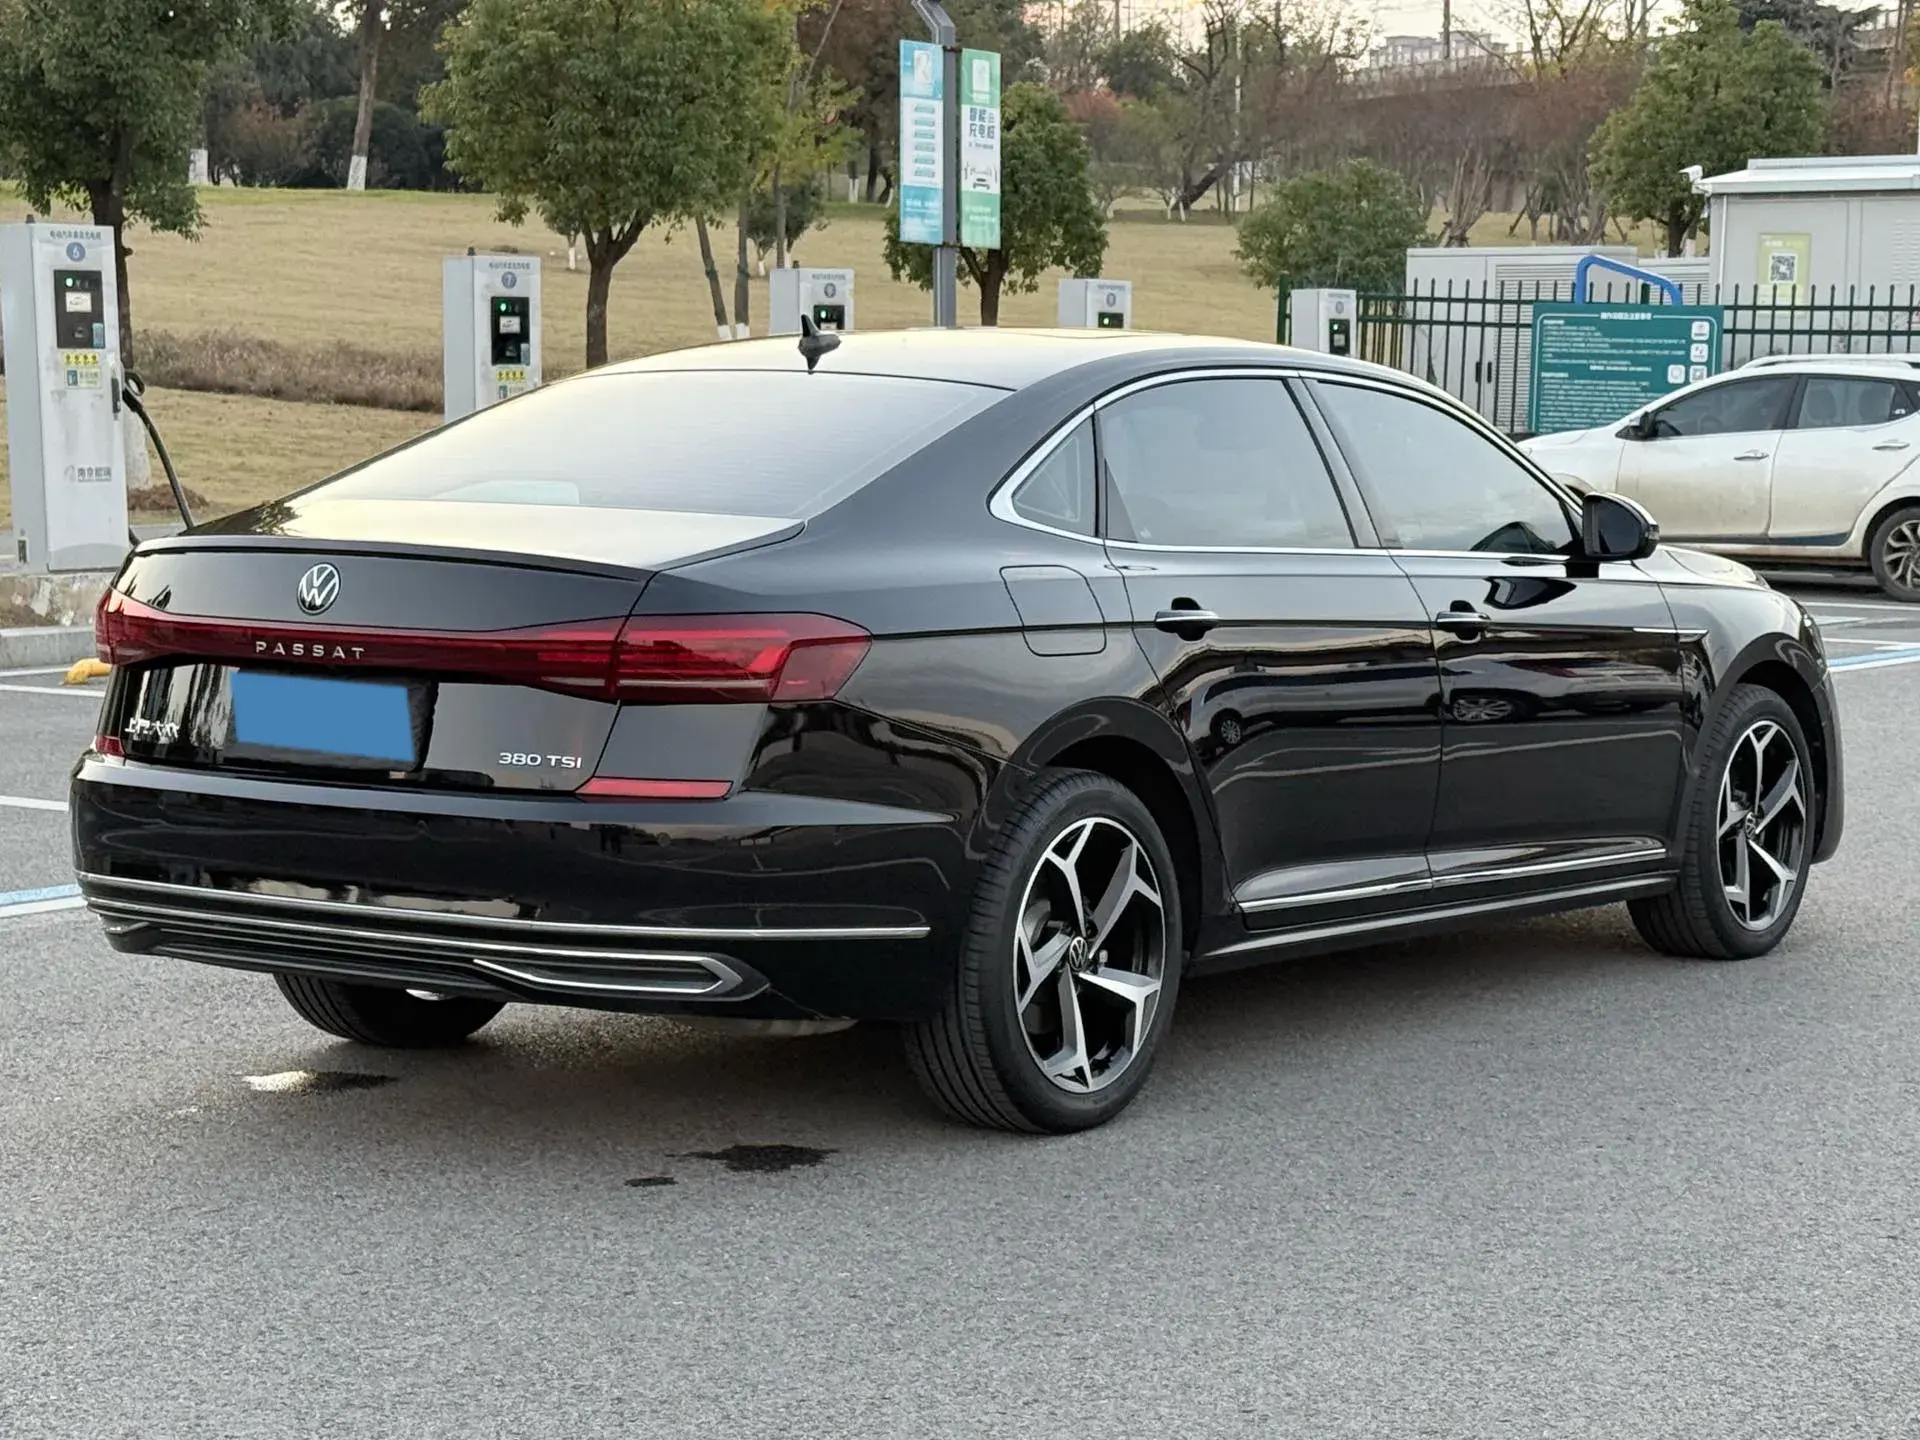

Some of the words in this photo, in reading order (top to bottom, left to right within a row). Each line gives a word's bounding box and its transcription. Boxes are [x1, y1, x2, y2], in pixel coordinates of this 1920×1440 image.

[255, 641, 365, 660] PASSAT
[499, 752, 542, 766] 380
[546, 755, 582, 769] TSI
